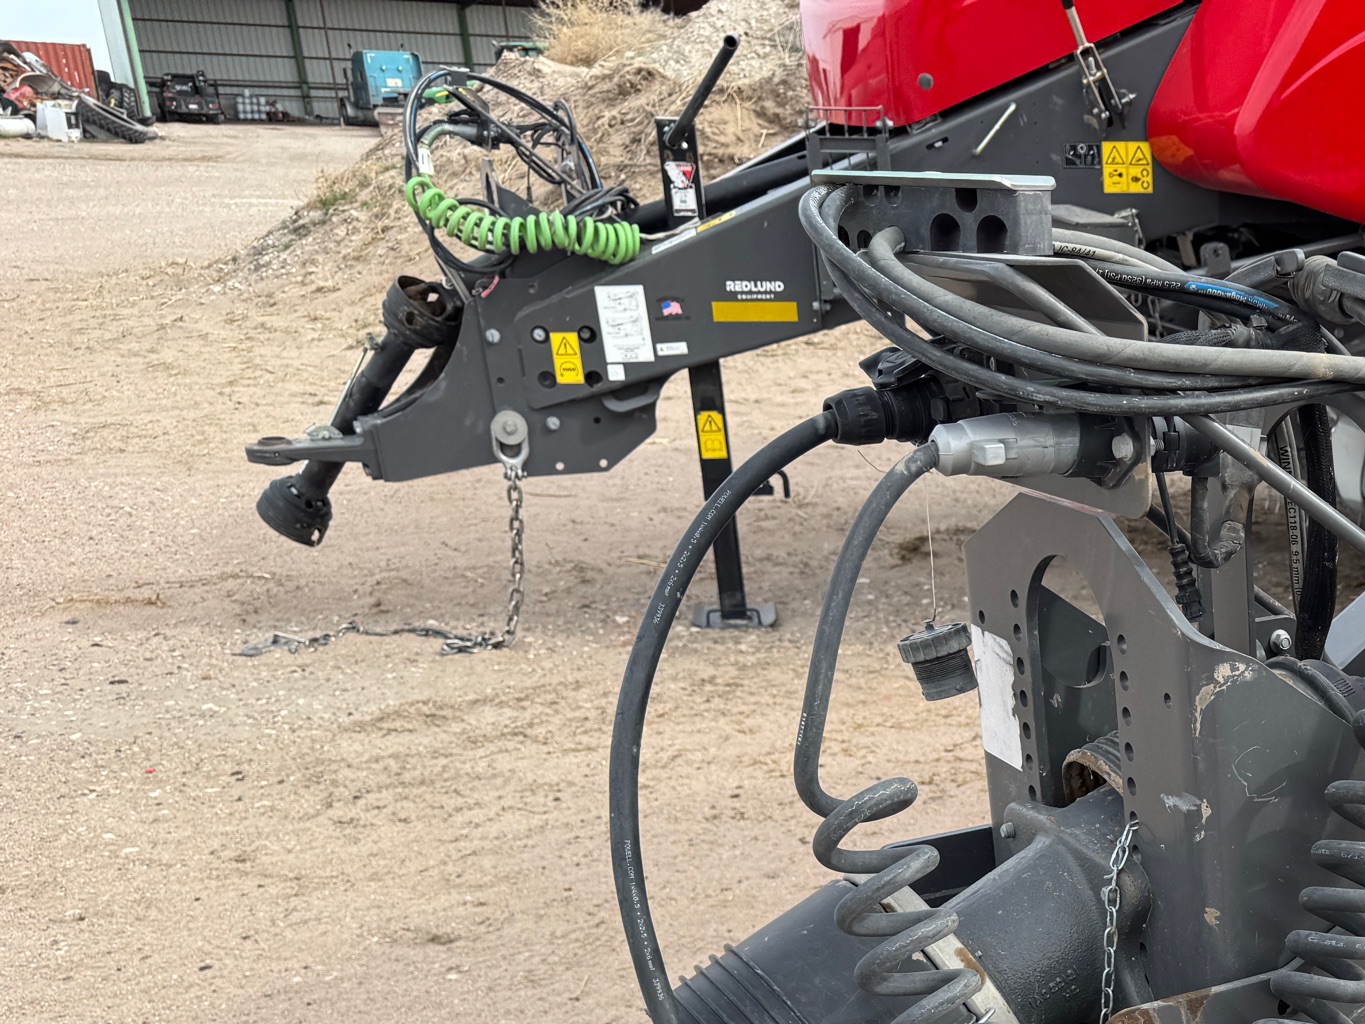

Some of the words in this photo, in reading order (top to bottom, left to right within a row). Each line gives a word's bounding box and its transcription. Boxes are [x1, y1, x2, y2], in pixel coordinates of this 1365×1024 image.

[725, 280, 785, 292] REDLUND
[1146, 278, 1163, 287] MPa
[1164, 281, 1181, 289] 22.5
